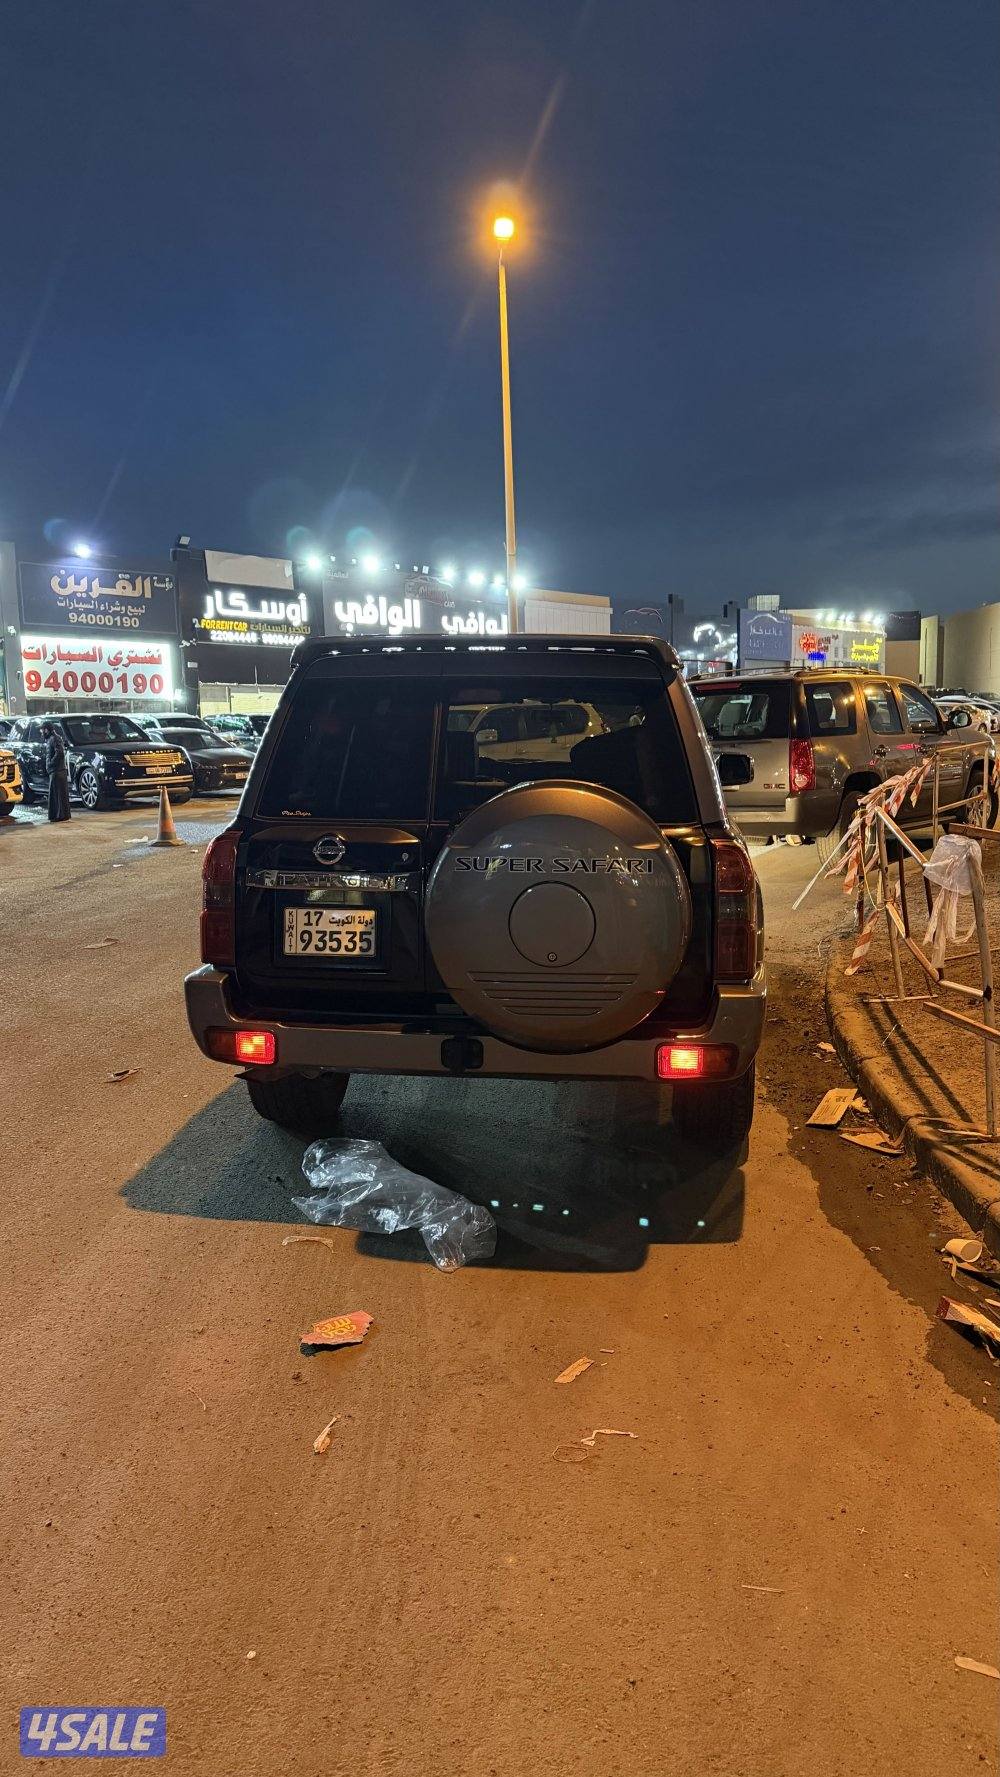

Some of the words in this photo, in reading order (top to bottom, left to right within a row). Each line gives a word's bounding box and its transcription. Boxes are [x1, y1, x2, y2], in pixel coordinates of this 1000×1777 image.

[50, 570, 152, 598] القرين
[57, 597, 98, 611] السيارات
[203, 590, 308, 627] أوسكار
[334, 594, 421, 634] الوافي
[68, 612, 140, 628] 94000190
[202, 619, 219, 629] FOR
[218, 620, 234, 630] RENT
[233, 622, 248, 631] CAR
[22, 643, 103, 666] السيارات
[108, 649, 163, 671] نشتري
[25, 669, 164, 694] 94000190
[454, 856, 547, 873] SUPER
[551, 857, 654, 874] SAFARI
[303, 910, 323, 927] 17
[328, 915, 356, 927] الكويت
[357, 915, 374, 927] دولة
[287, 911, 295, 952] KUWAIT
[299, 929, 373, 952] 93535
